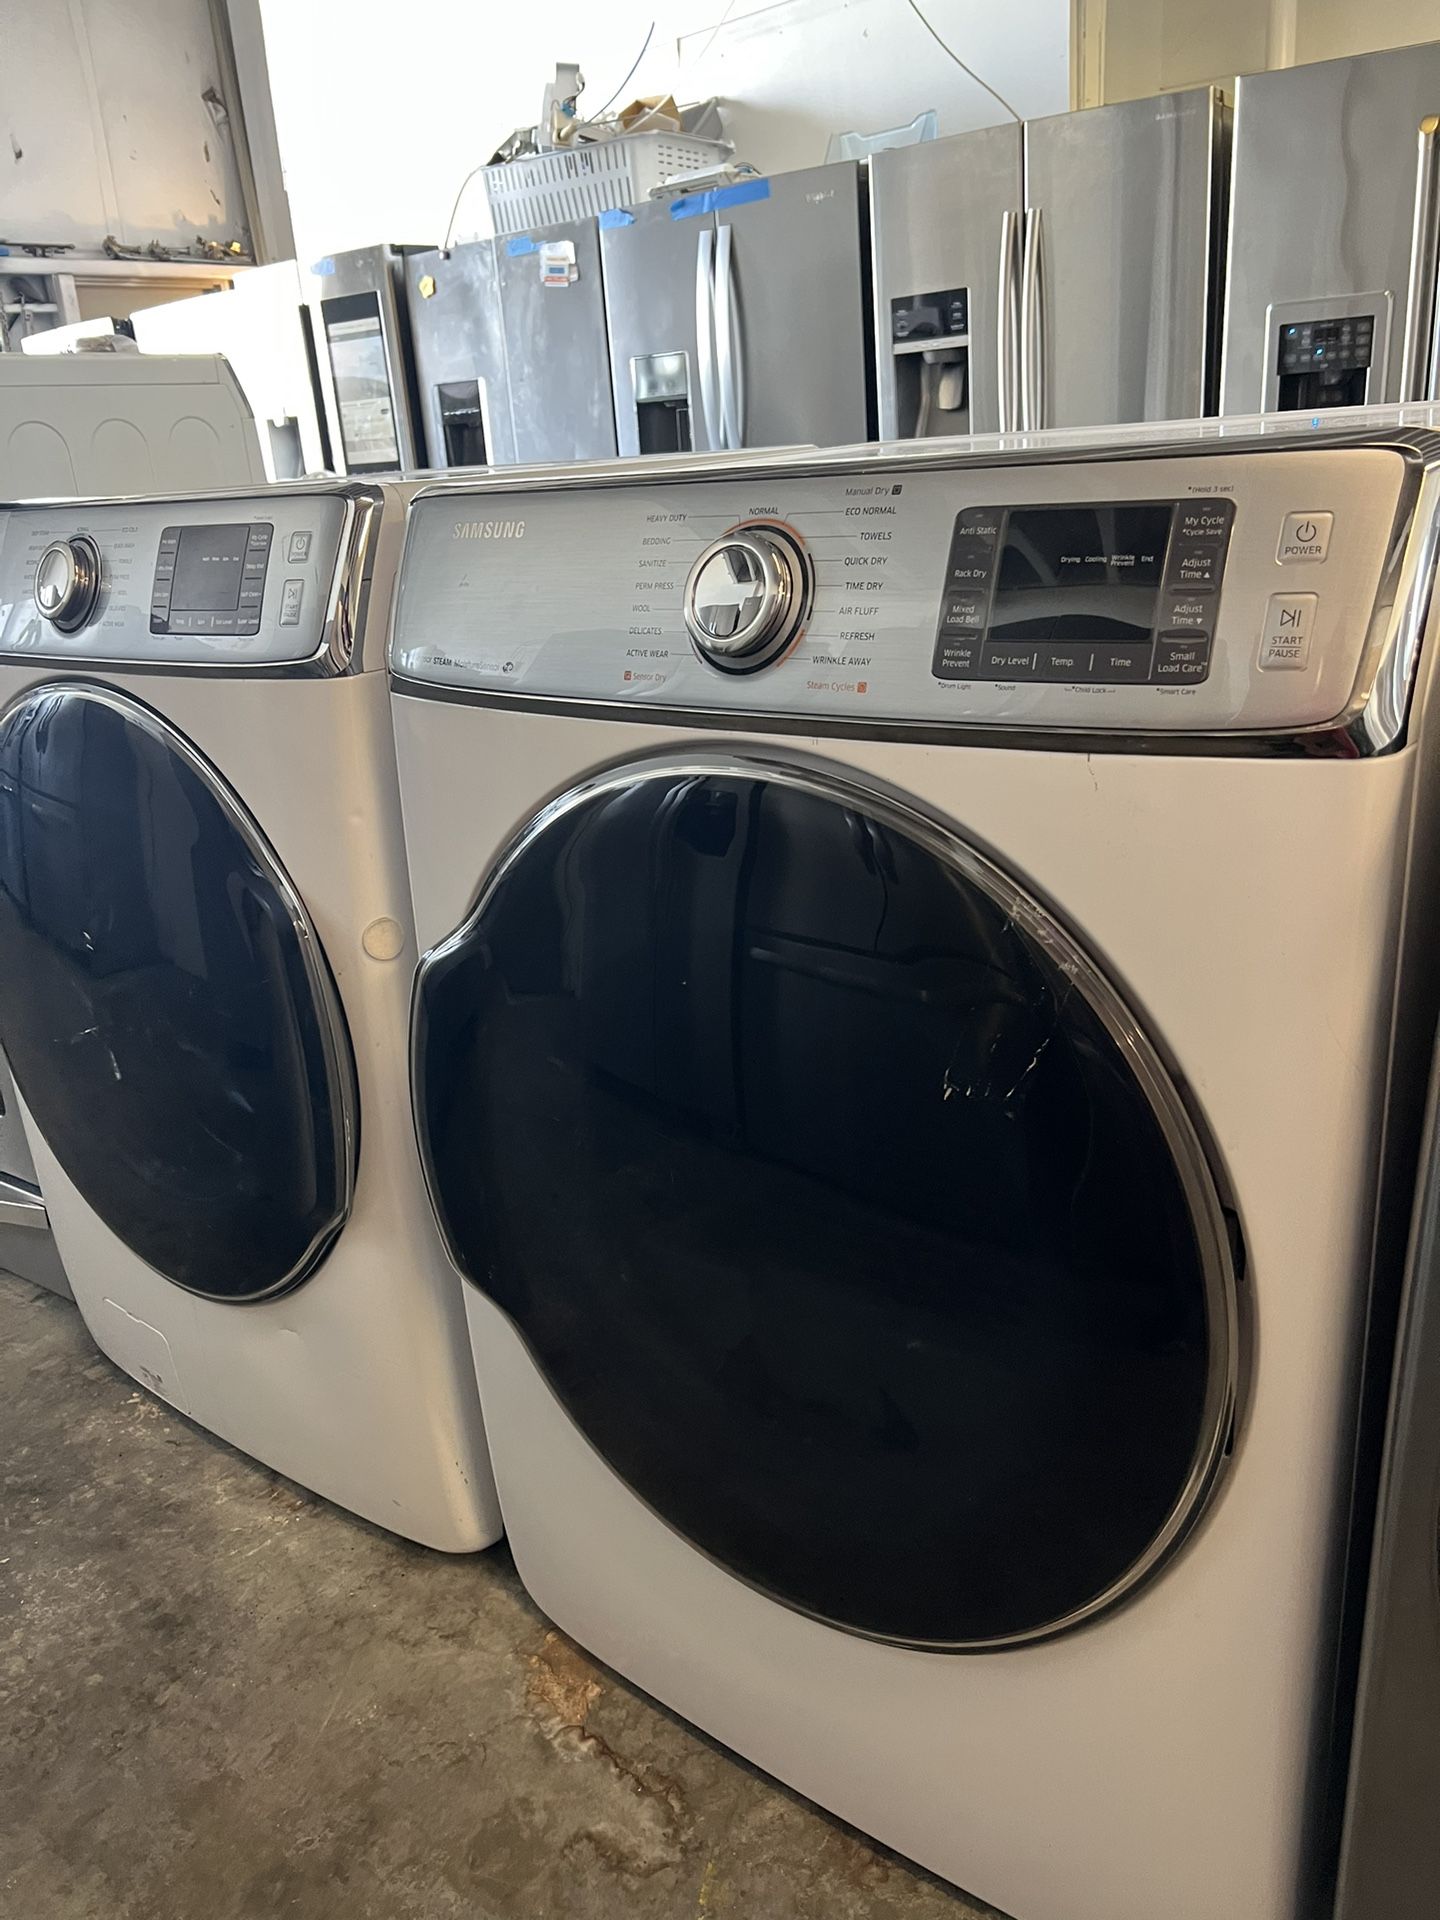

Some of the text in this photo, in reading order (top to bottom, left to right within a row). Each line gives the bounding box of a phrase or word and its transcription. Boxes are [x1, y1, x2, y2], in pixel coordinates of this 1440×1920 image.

[845, 487, 890, 496] Manual Dry
[845, 504, 896, 516] ECO NORMAL
[646, 513, 687, 523] HEAVY DUTY
[1184, 515, 1225, 526] My Cycle
[453, 521, 525, 539] SAMSUNG
[960, 526, 998, 535] Anti Static
[860, 532, 892, 540] TOWELS
[642, 537, 671, 545] BEDDING
[1284, 546, 1323, 555] POWER
[844, 556, 888, 566] QUICK DRY
[1181, 558, 1212, 569] Adjust
[954, 569, 987, 579] Rack Dry
[1179, 570, 1202, 579] Time
[635, 581, 674, 590] PERM PRESS
[846, 582, 884, 590] TIME DRY
[632, 604, 651, 613] WOOL
[839, 606, 879, 615] AIR FLUFF
[952, 605, 975, 614] Mixed
[1173, 604, 1203, 614] Adjust
[946, 616, 964, 624] Load
[1171, 616, 1194, 625] Time
[628, 626, 662, 635] DELICATES
[840, 632, 875, 640] REFRESH
[1271, 636, 1303, 645] START
[626, 649, 669, 658] ACTIVE WEAR
[943, 648, 972, 658] Wrinkle
[1169, 652, 1195, 661] Small
[1269, 649, 1300, 658] PAUSE
[433, 657, 452, 666] STEAM
[812, 656, 872, 666] WRINKLE AWAY
[942, 659, 971, 669] Prevent
[991, 656, 1030, 666] Dry Level
[1110, 658, 1132, 667] Time
[1157, 664, 1180, 673] Load
[633, 672, 667, 682] Sensor Dry
[807, 680, 856, 692] Steam Cycles
